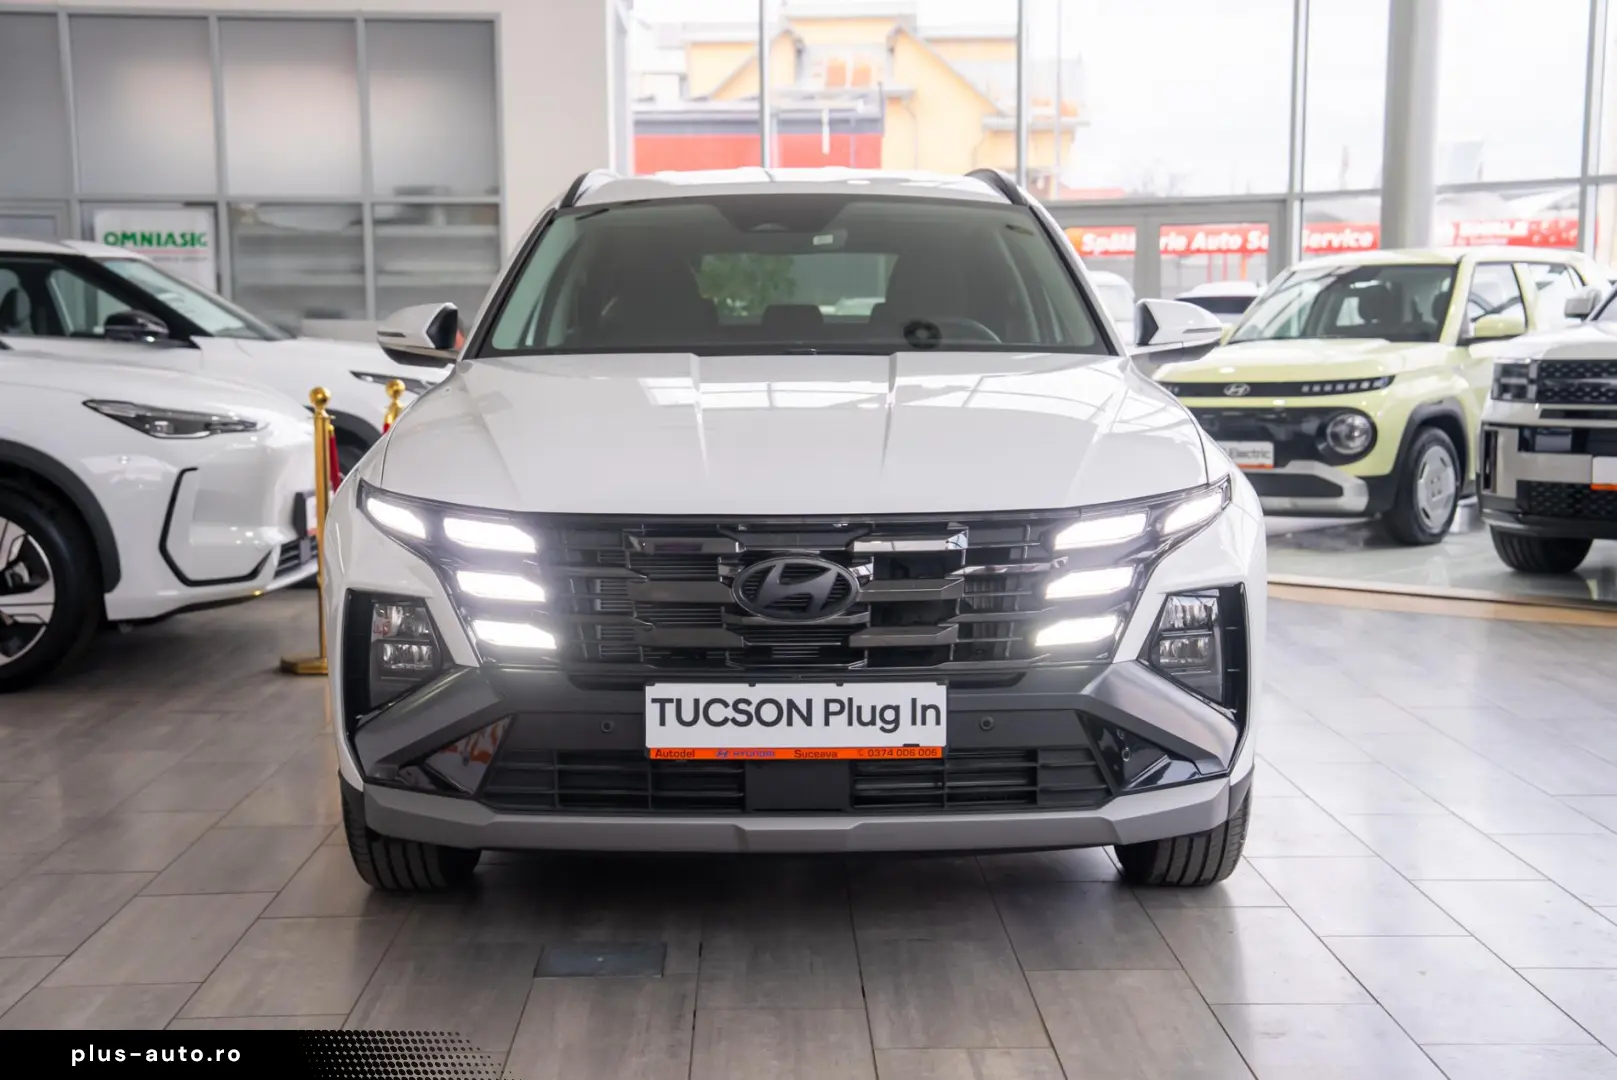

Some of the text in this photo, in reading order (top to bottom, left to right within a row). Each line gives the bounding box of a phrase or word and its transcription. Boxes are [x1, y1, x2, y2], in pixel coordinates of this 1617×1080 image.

[1191, 230, 1243, 250] Auto
[651, 697, 941, 734] TUCSON Plug In
[655, 749, 695, 758] Autodel
[794, 749, 838, 759] Suceava
[867, 748, 893, 757] 0374
[896, 748, 916, 757] 006
[918, 747, 938, 757] 006
